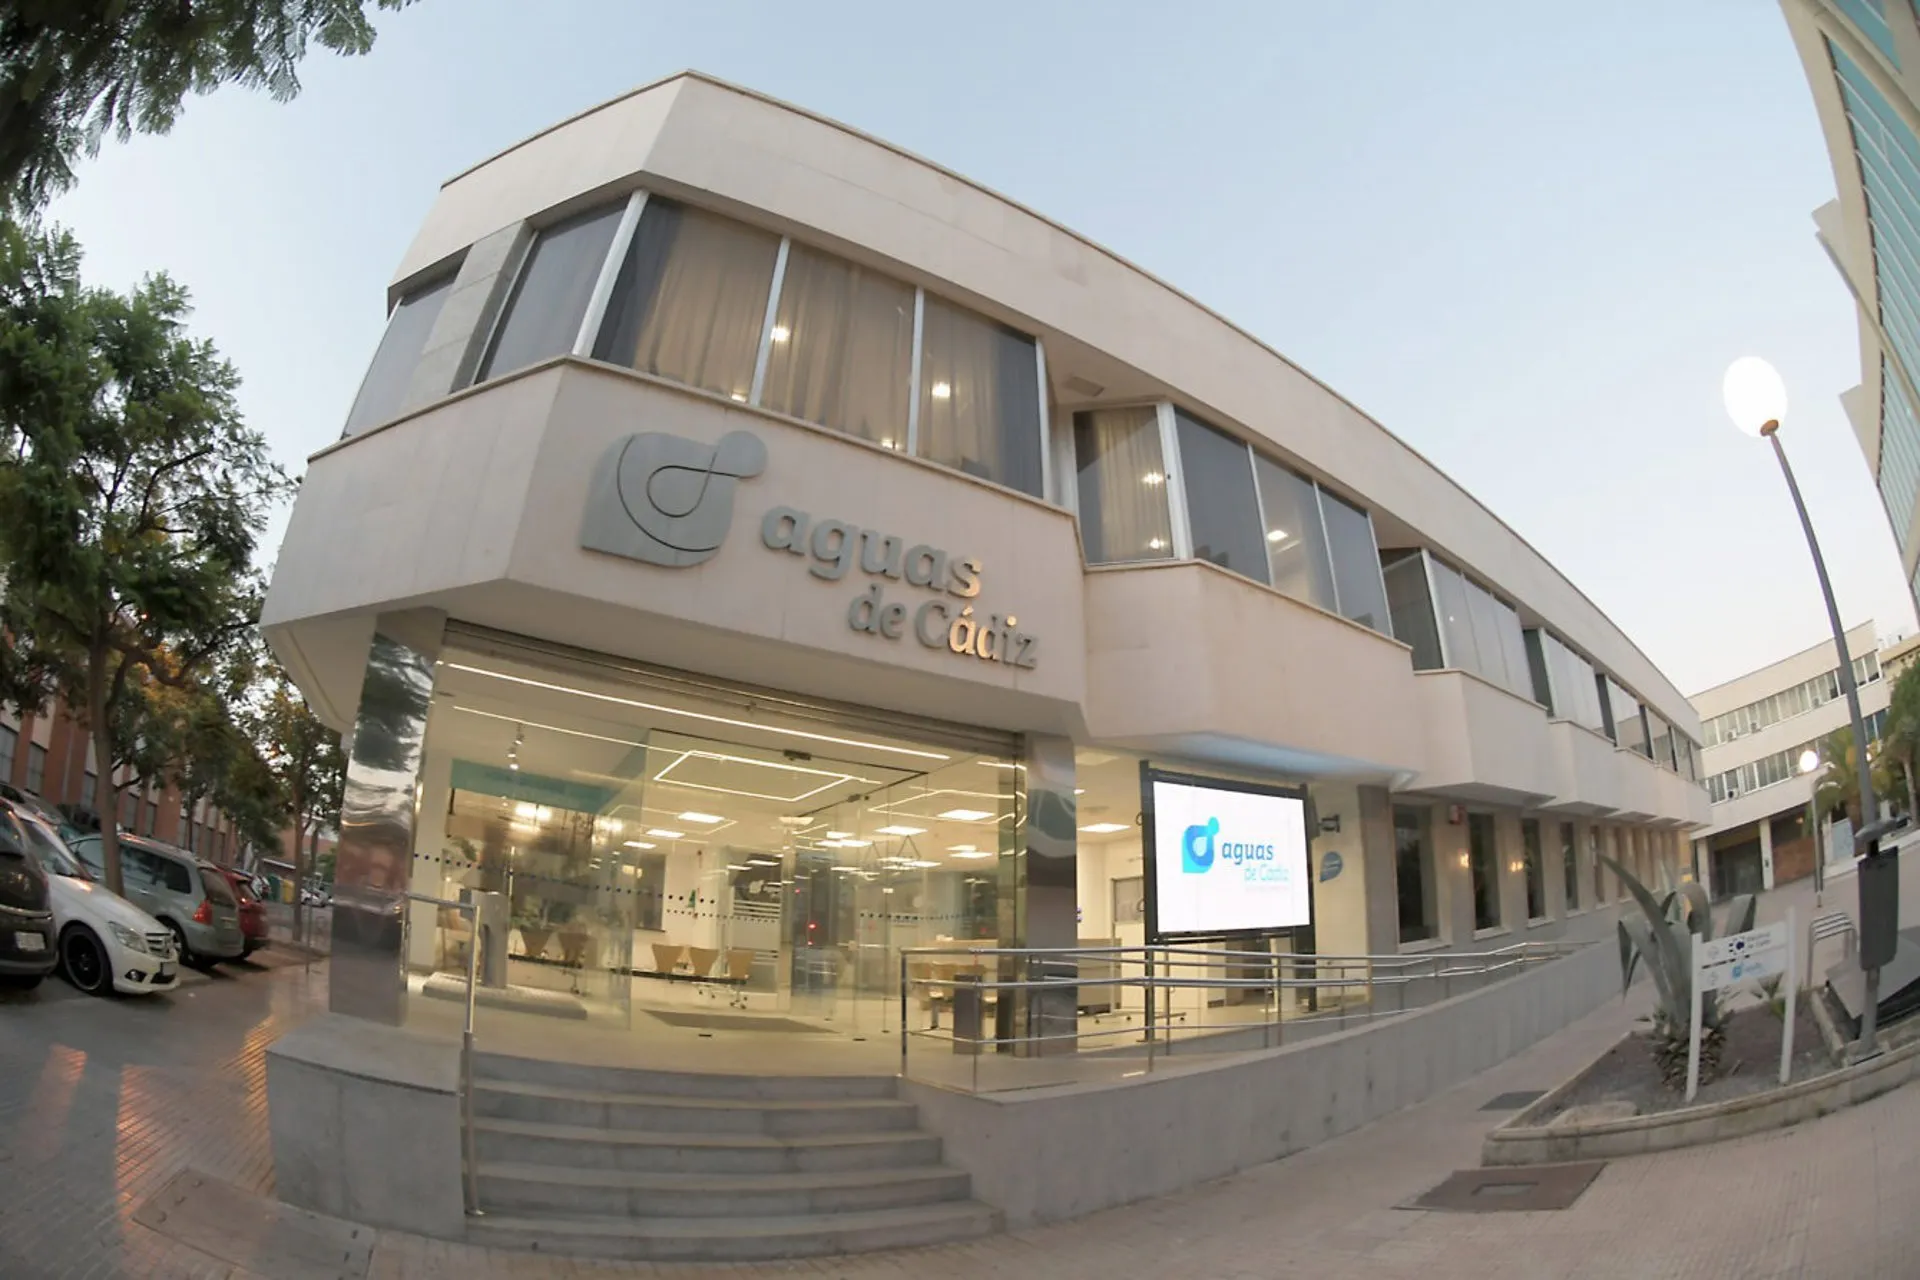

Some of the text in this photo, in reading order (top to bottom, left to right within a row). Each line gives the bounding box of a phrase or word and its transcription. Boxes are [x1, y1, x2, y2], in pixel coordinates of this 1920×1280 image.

[761, 505, 981, 598] aguas
[849, 584, 1039, 669] de Cádiz
[1222, 842, 1273, 865] aguas
